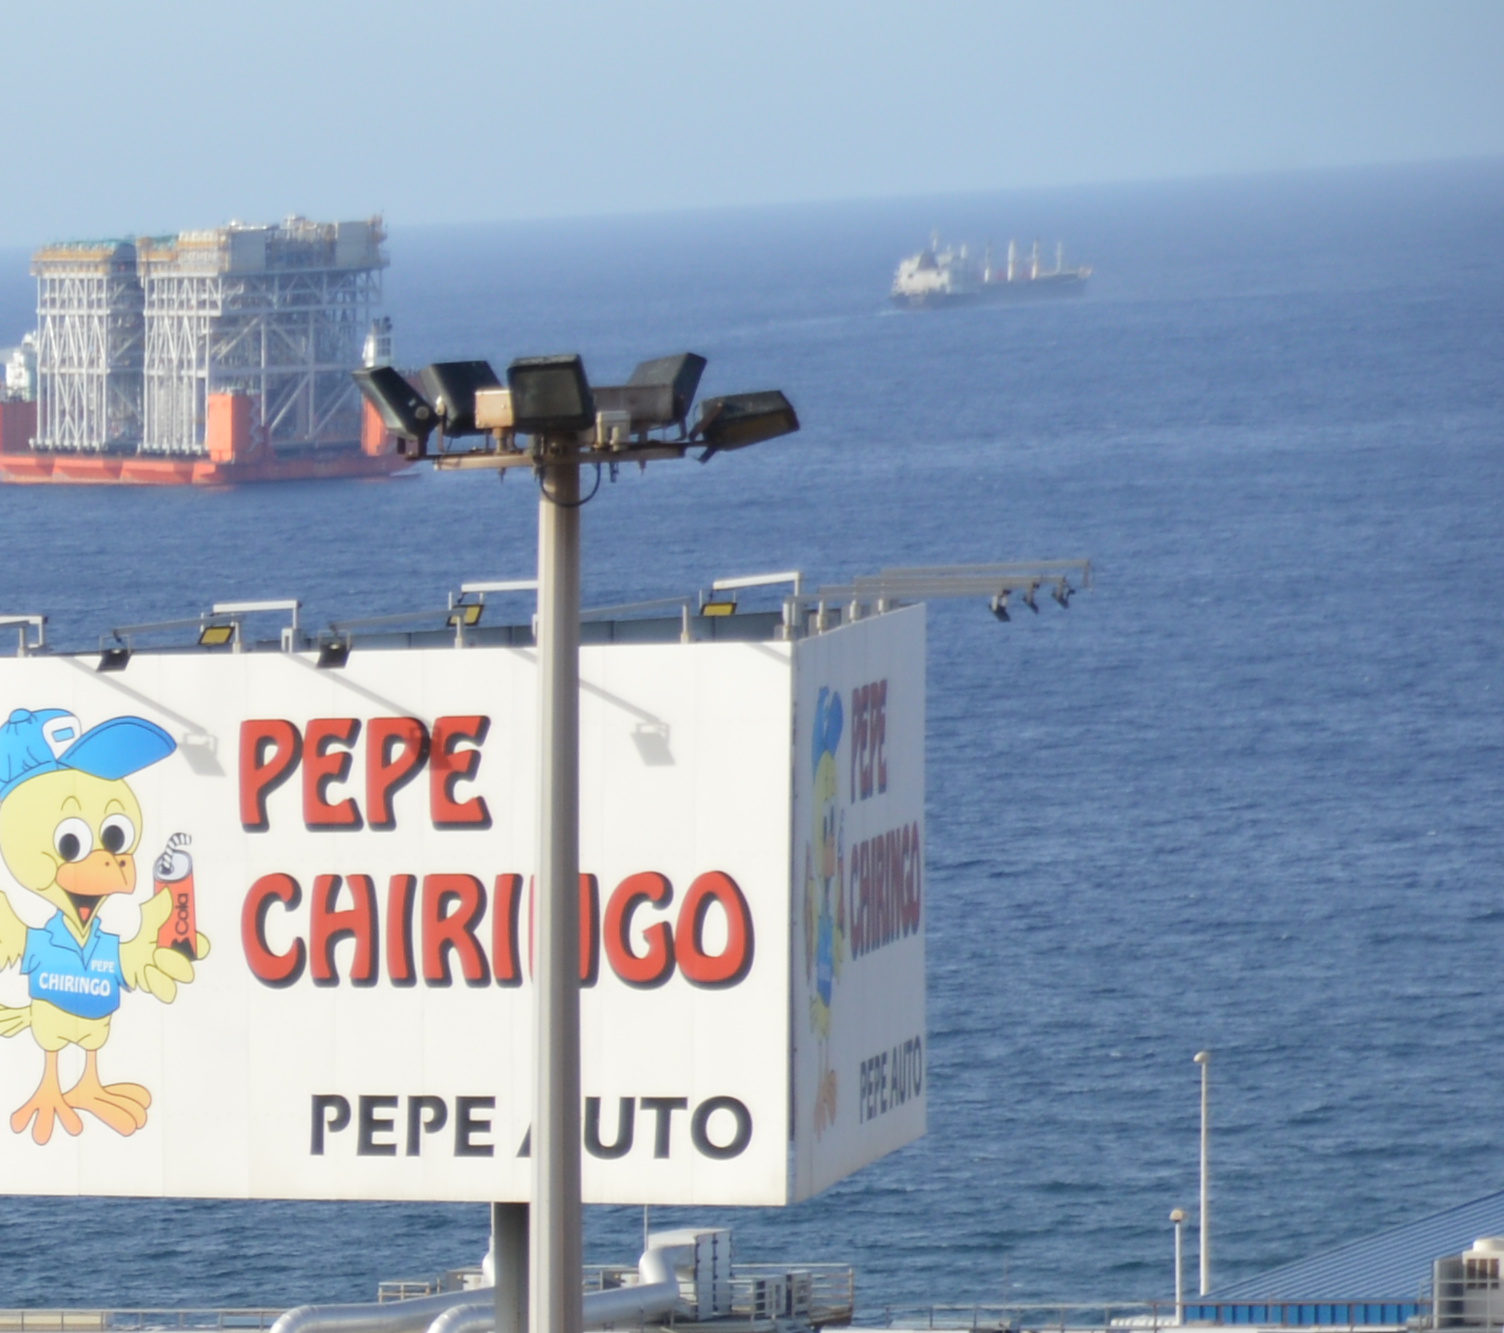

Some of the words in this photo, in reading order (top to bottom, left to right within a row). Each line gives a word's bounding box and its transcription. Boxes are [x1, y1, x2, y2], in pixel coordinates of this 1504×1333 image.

[238, 715, 492, 832] PEPE
[850, 679, 888, 803] PEPE
[849, 820, 921, 962] CHIRINGO
[38, 971, 111, 998] CHIRINGO
[90, 959, 116, 974] PEPE
[859, 1048, 888, 1125] PEPE
[891, 1035, 923, 1109] AUTO
[311, 1094, 496, 1159] PEPE
[515, 1095, 754, 1160] UTO
